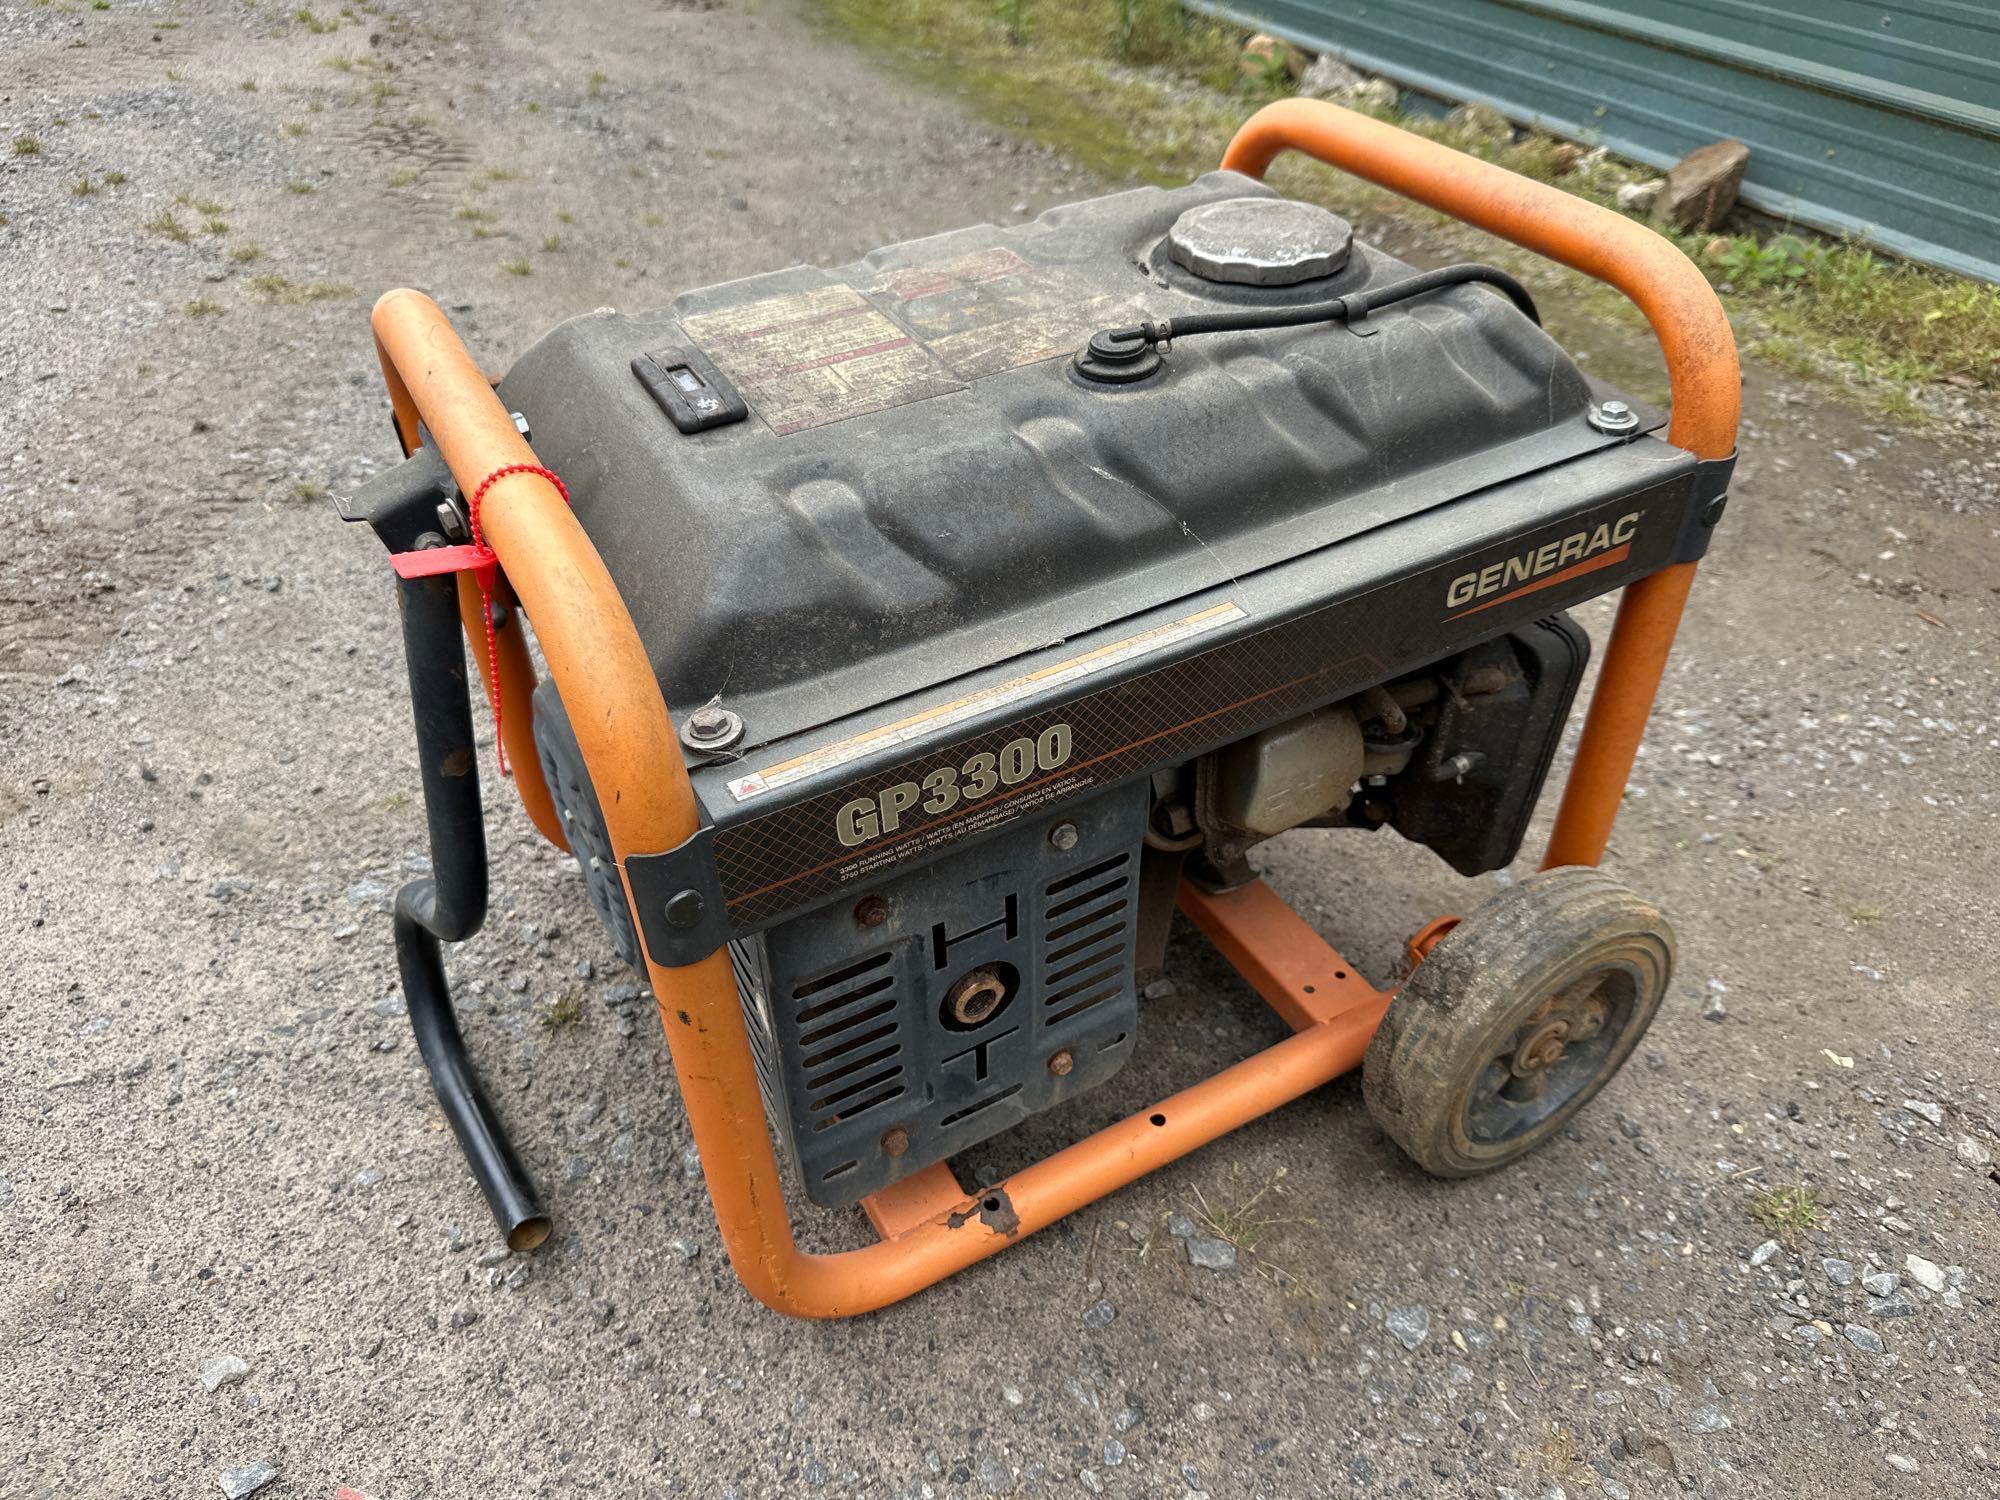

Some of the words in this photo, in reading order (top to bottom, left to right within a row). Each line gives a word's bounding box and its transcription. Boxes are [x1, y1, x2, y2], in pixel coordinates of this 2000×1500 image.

[1446, 511, 1640, 609] GENERAC
[836, 723, 1072, 847] GP3300
[840, 863, 858, 874] 3300
[859, 848, 894, 867] RUNNING
[894, 837, 921, 852] WATTS
[926, 827, 951, 840] WATTS
[952, 819, 965, 830] (EN
[965, 807, 999, 824] MARCHE)
[1003, 791, 1041, 809] CONSUMO
[1041, 785, 1052, 795] EN
[1052, 776, 1077, 790] VATIOS
[860, 856, 897, 874] STARTING
[897, 844, 924, 859] WATTS
[928, 832, 954, 846] WATTS
[954, 827, 967, 838] (AU
[1020, 797, 1045, 810] VATIOS
[1045, 792, 1055, 800] DE
[1055, 776, 1094, 796] ARRANQUE
